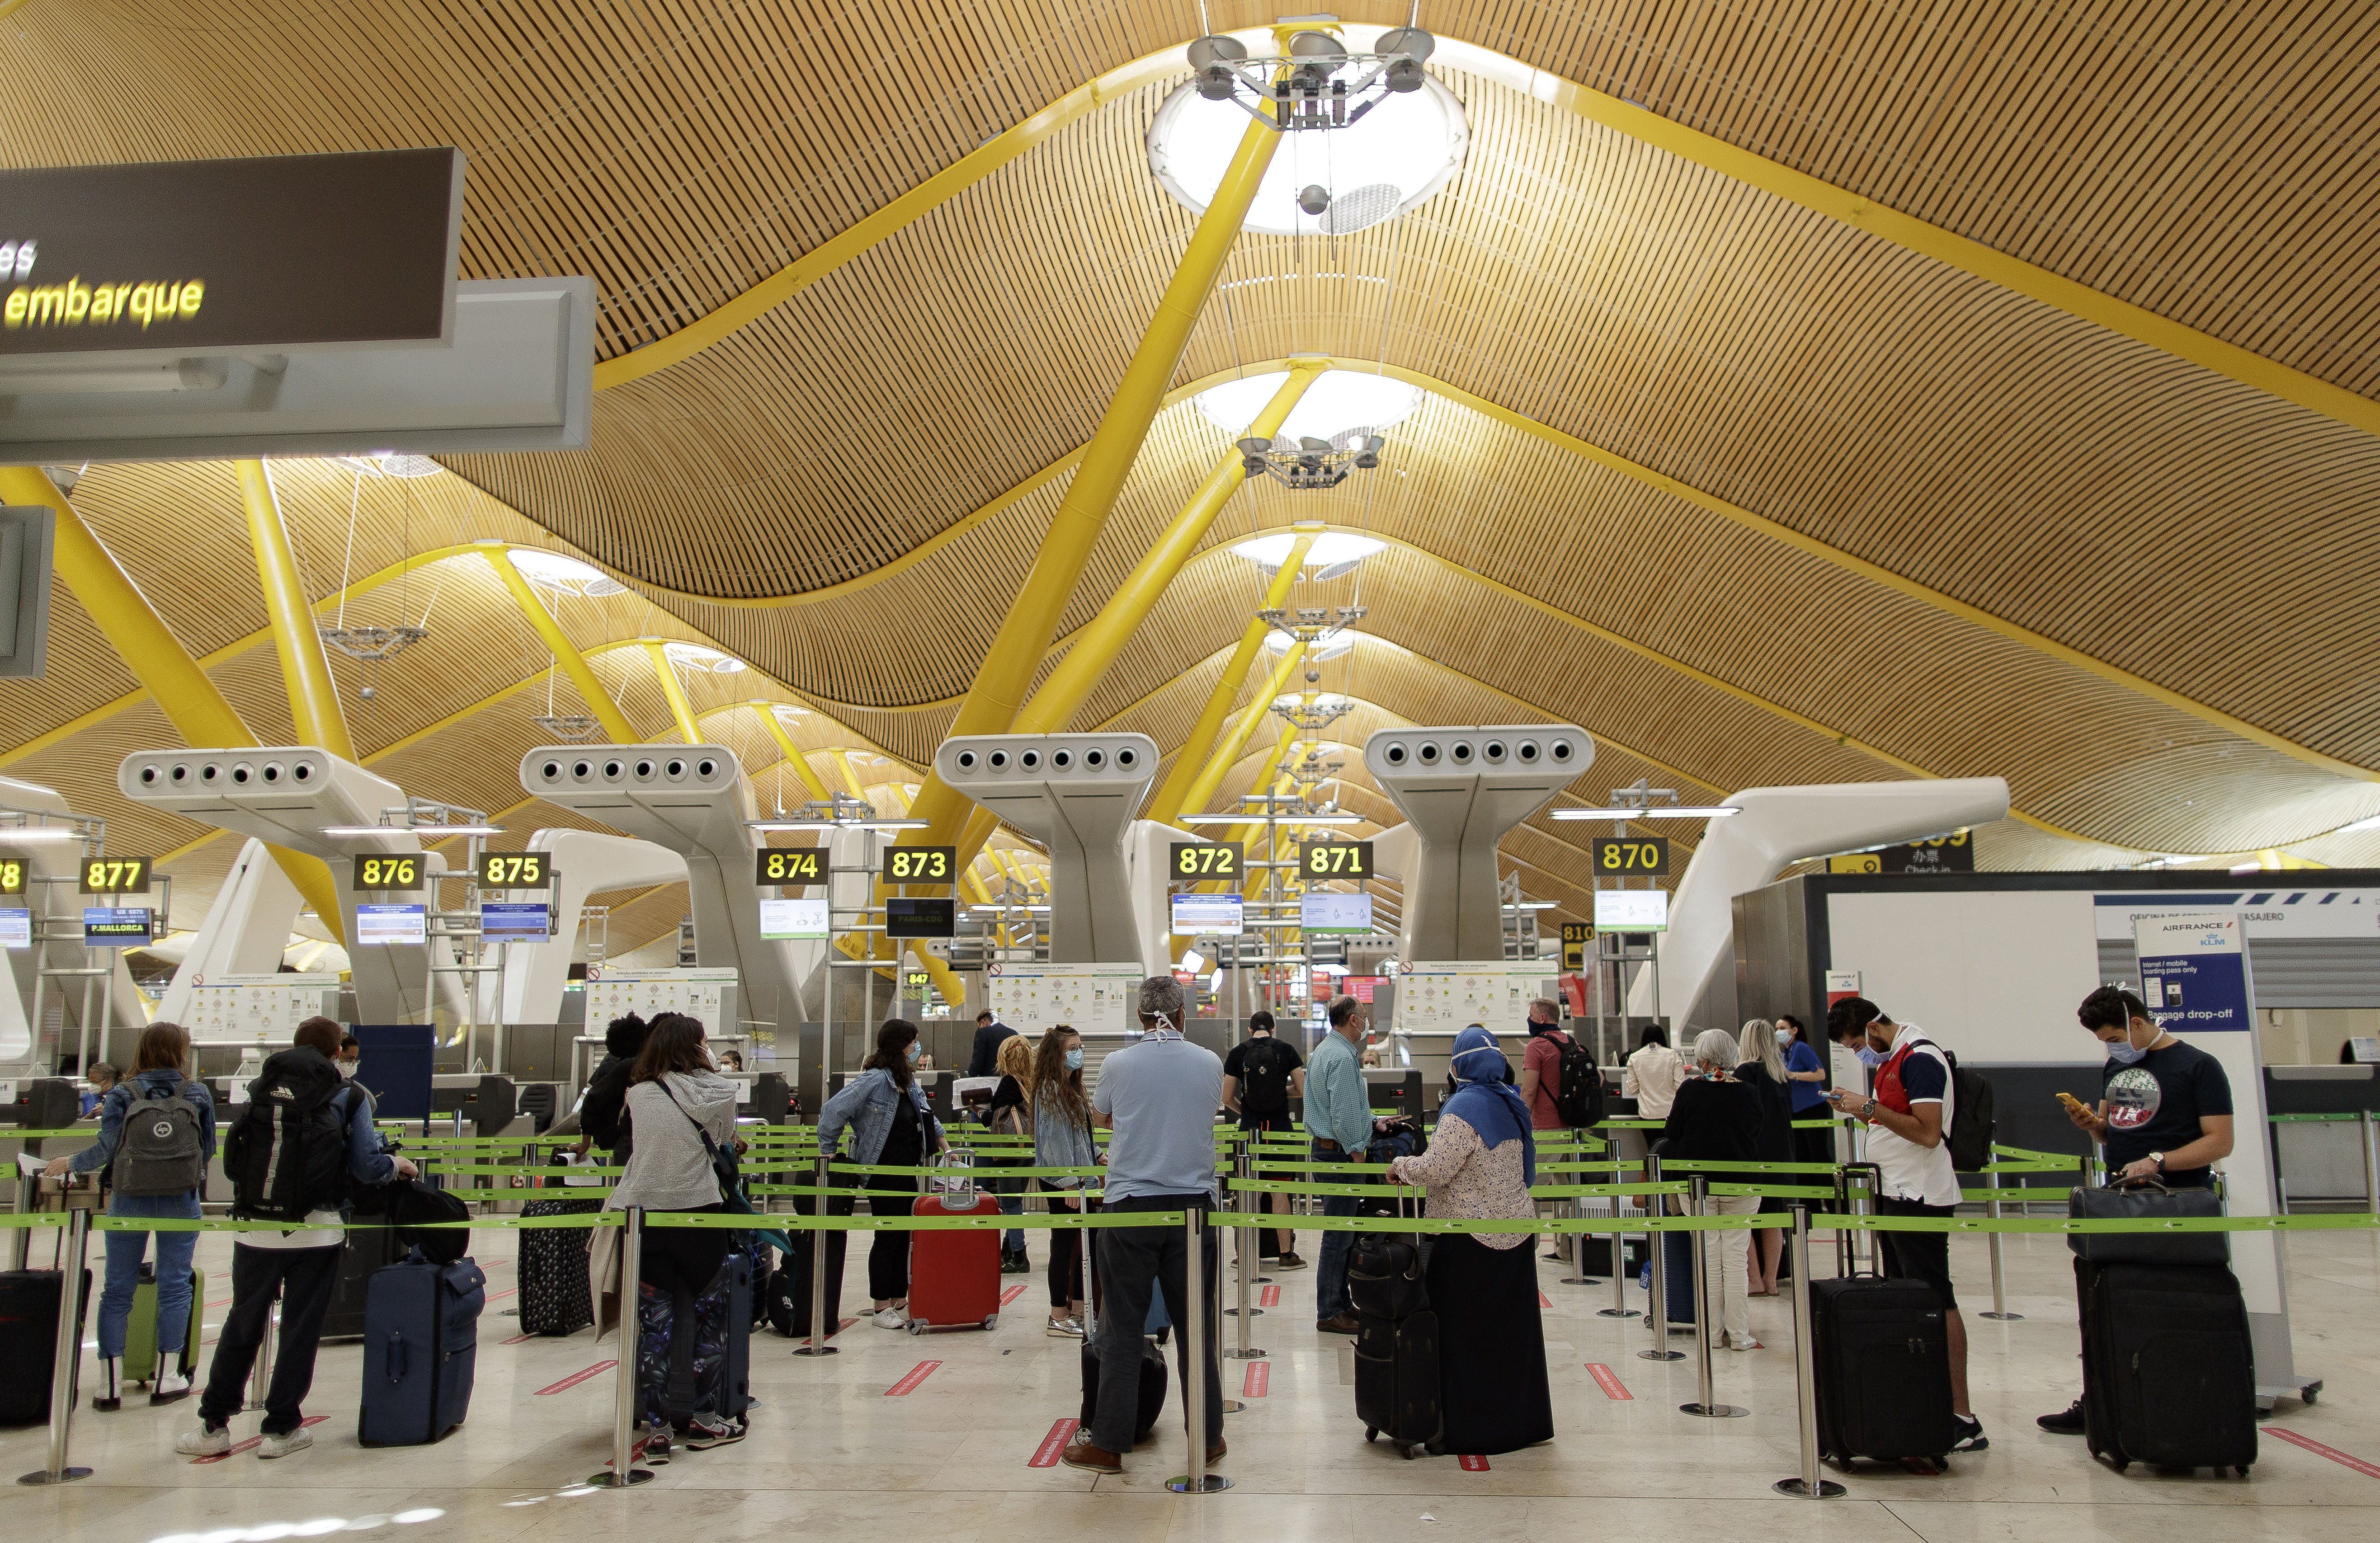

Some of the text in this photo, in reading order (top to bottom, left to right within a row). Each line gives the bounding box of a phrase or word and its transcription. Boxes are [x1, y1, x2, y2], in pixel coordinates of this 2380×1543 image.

[5, 278, 203, 325] embarque
[768, 854, 818, 878] 874
[892, 852, 946, 877] 873
[1179, 848, 1234, 873] 872
[1310, 847, 1362, 873] 871
[1603, 844, 1659, 869] 870
[0, 864, 20, 887] 8
[88, 862, 141, 887] 877
[363, 860, 415, 884] 876
[487, 857, 540, 882] 875
[1564, 926, 1594, 940] 810
[2163, 922, 2224, 932] AIRFRANCE
[909, 974, 928, 984] 847
[2147, 1009, 2233, 1021] Baggage drop-off
